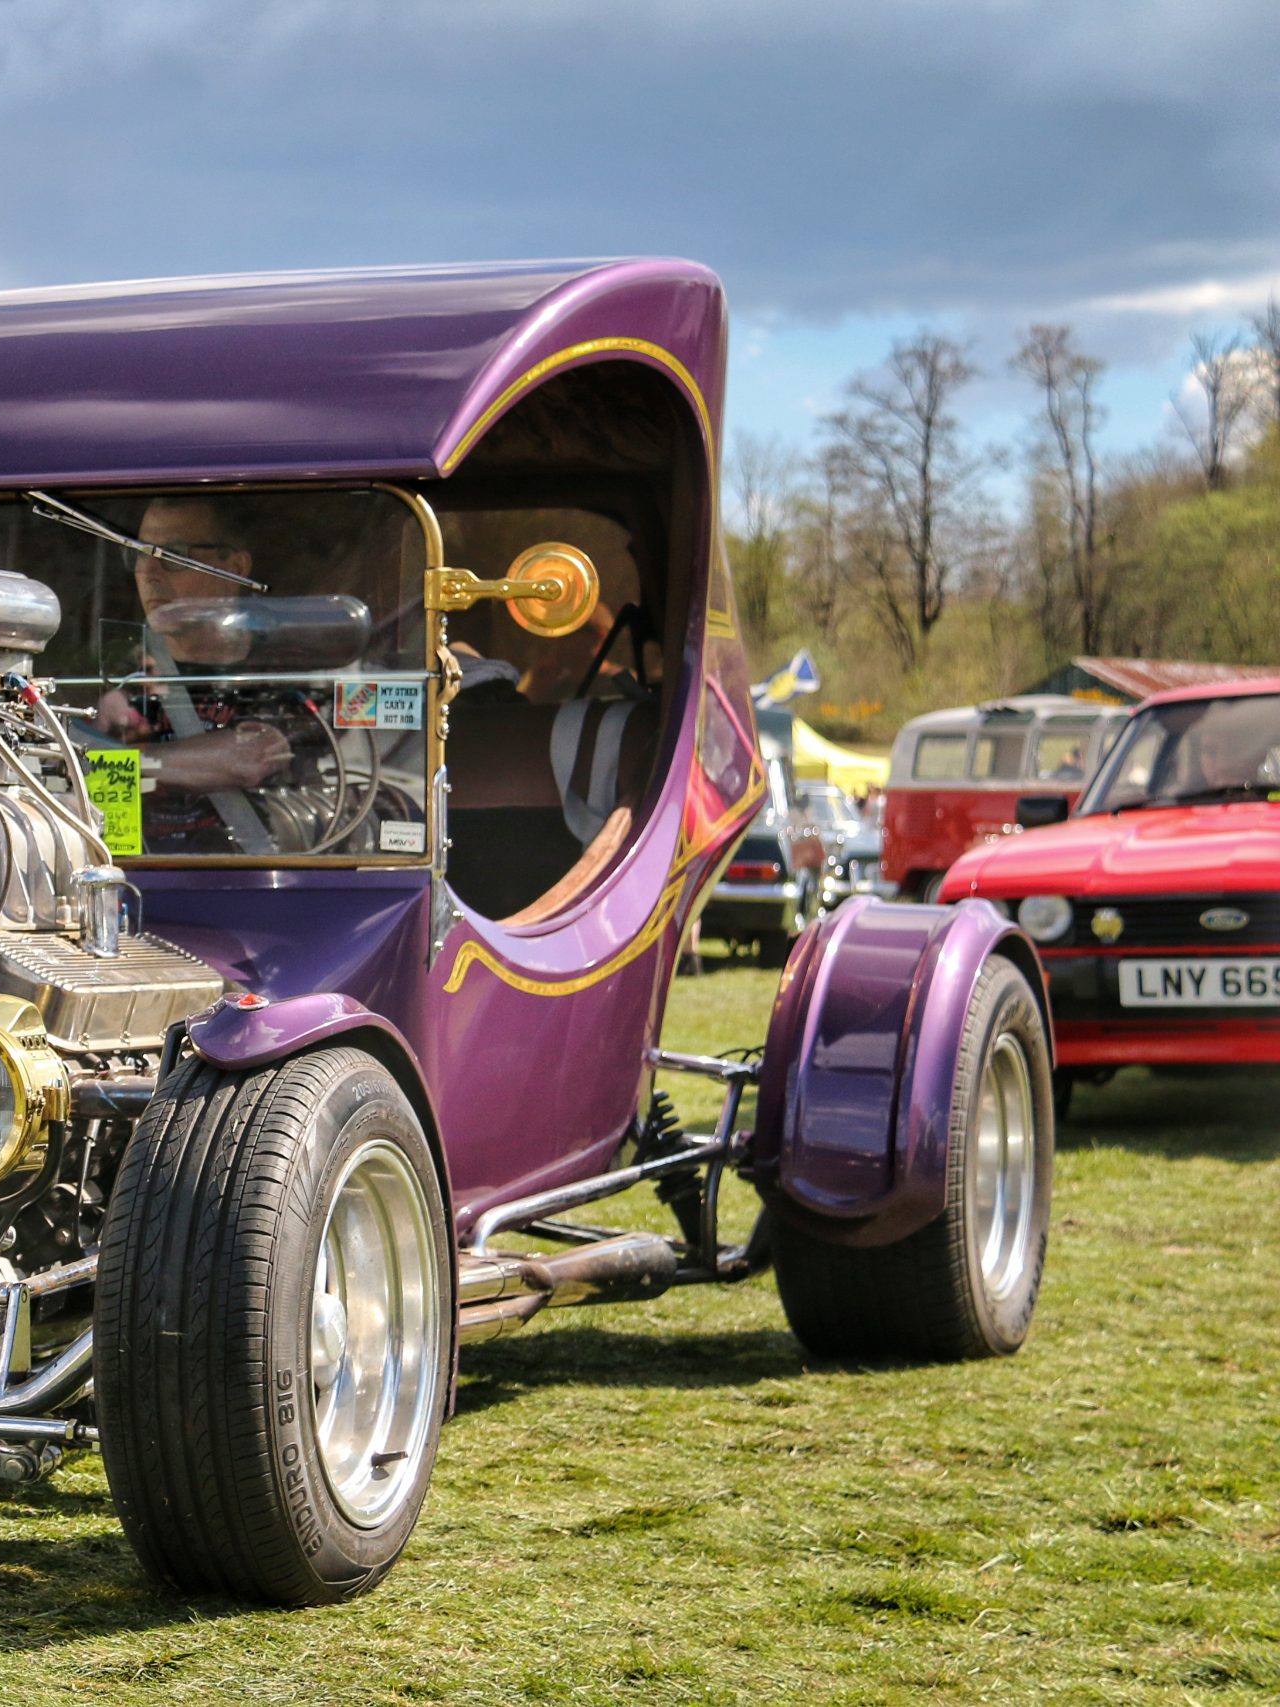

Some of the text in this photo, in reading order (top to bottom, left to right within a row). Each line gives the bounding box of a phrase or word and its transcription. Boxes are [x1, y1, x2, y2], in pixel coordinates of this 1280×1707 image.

[381, 687, 418, 696] MY OTHER
[384, 699, 414, 710] CAR'S A
[384, 715, 414, 724] HOT ROD
[107, 771, 136, 789] Day
[89, 791, 132, 803] 022
[1137, 967, 1206, 997] LNY
[277, 1367, 295, 1426] 816
[282, 1443, 323, 1558] ENDURO
